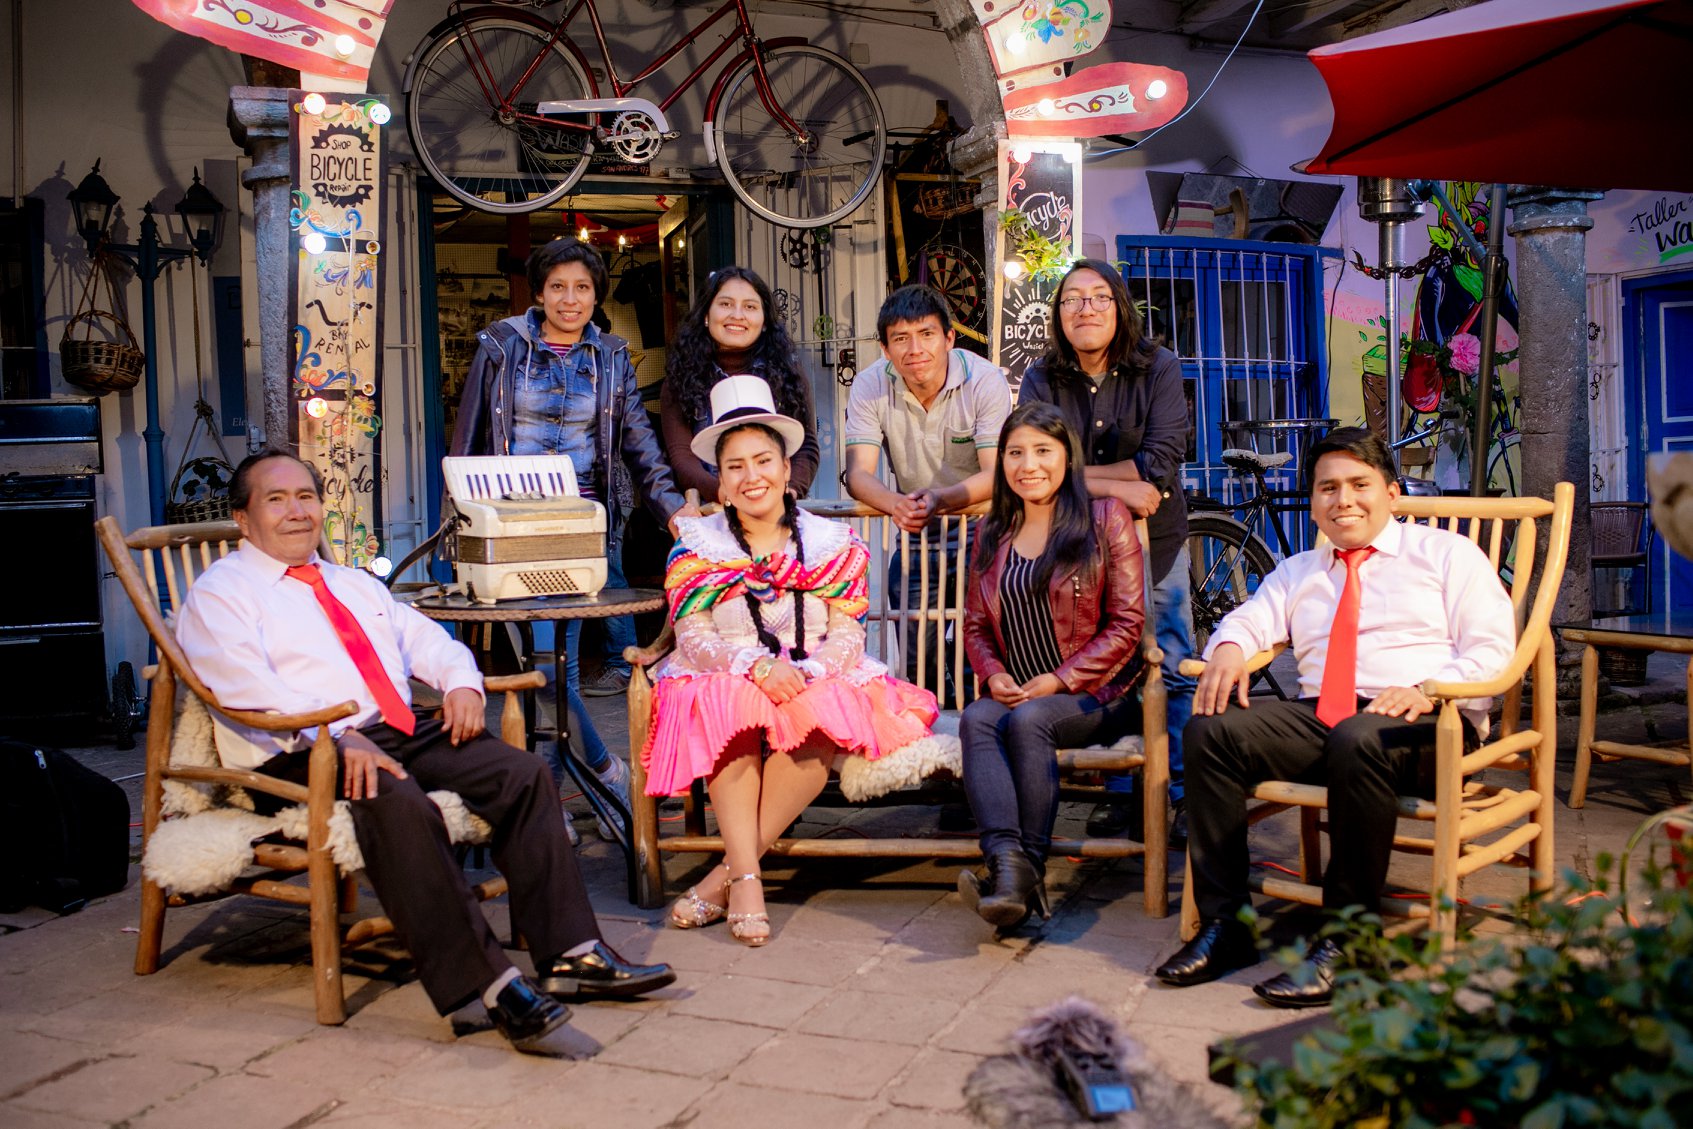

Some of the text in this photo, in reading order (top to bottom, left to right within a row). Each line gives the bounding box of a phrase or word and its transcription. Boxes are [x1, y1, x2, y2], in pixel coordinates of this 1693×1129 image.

[331, 139, 352, 150] SHOP
[310, 153, 373, 181] BICYCLE
[1021, 191, 1069, 233] icycle
[1630, 197, 1688, 234] Taller
[1655, 220, 1693, 252] Wa
[314, 337, 370, 354] RENAL
[1004, 324, 1050, 340] BICYCL
[321, 464, 374, 500] icyle
